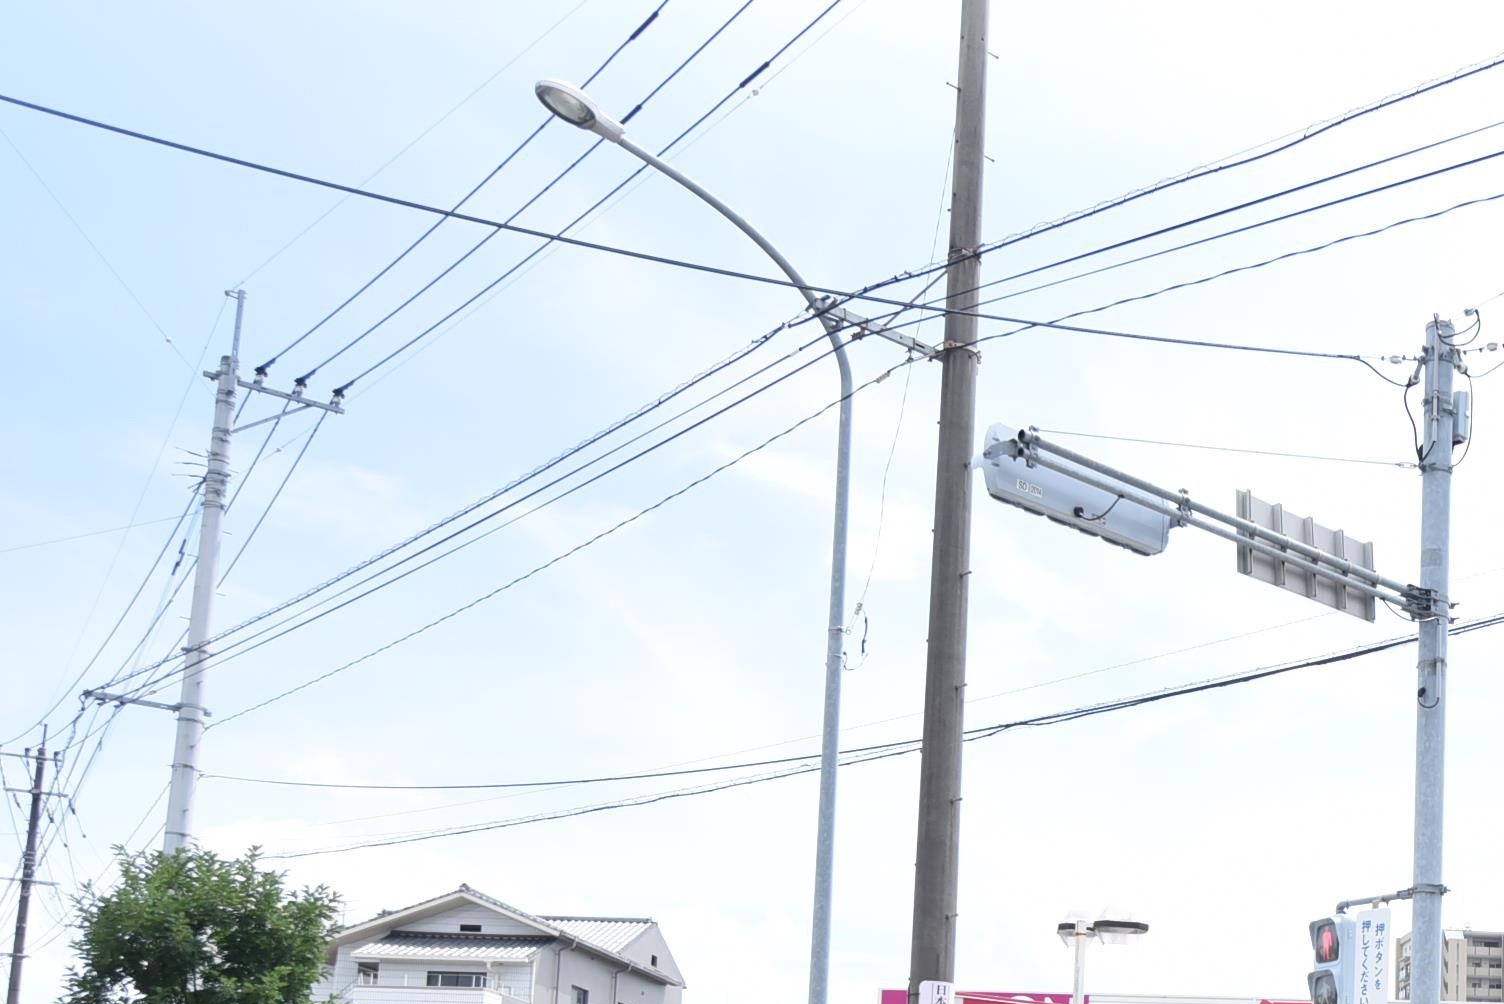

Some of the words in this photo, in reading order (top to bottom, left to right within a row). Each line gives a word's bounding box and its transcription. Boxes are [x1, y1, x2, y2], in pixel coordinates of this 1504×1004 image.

[1374, 922, 1385, 990] 押ボタンを
